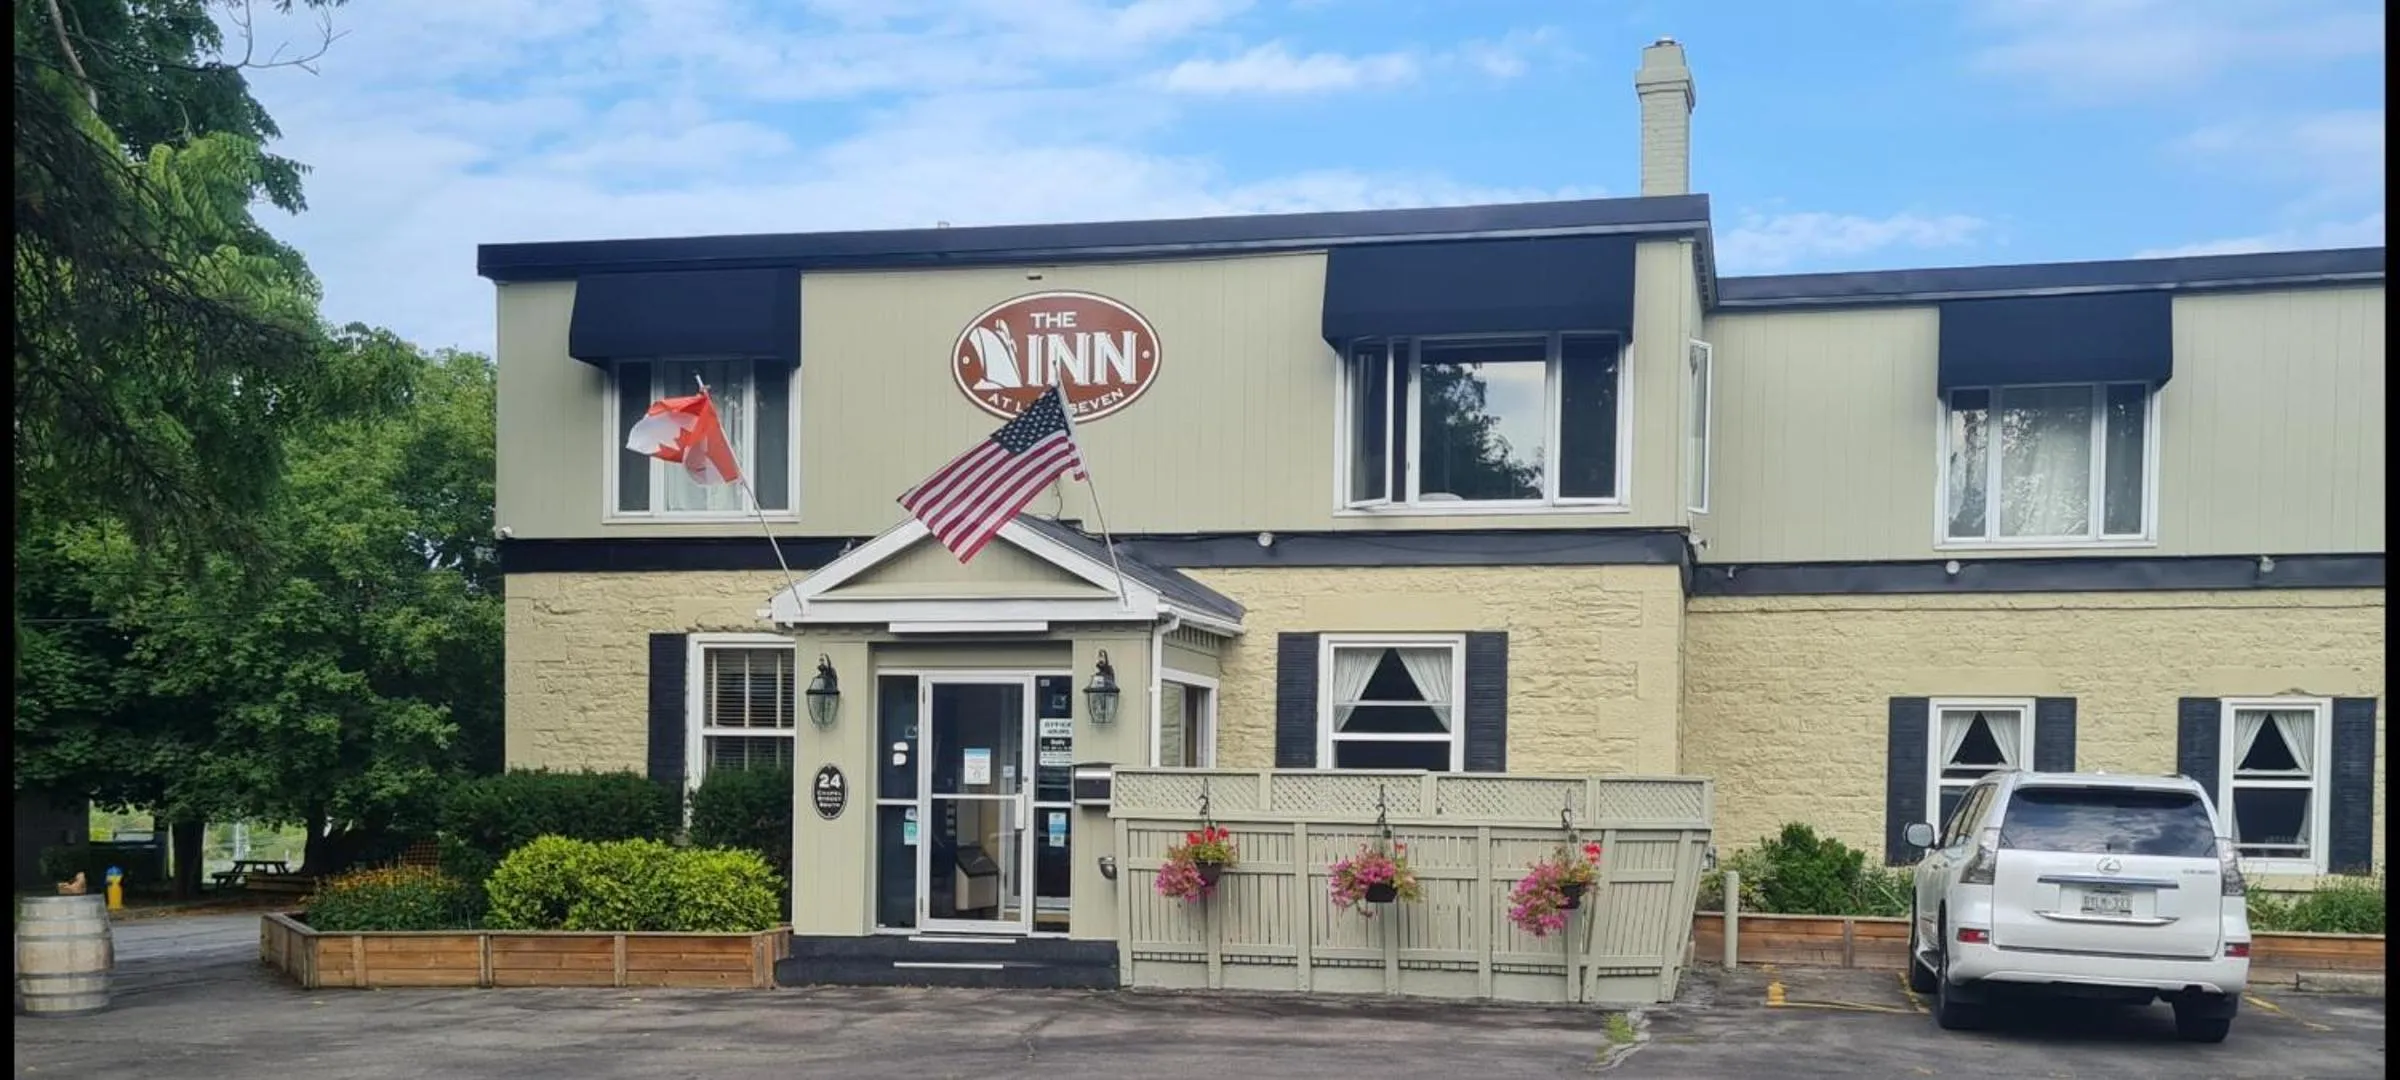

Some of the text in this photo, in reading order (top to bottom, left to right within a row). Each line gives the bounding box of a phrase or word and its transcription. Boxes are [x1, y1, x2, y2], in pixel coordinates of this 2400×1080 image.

[1030, 311, 1077, 328] THE
[1026, 330, 1139, 387] INN
[987, 393, 1012, 409] AT
[1070, 387, 1125, 414] SEVEN
[819, 773, 841, 788] 24
